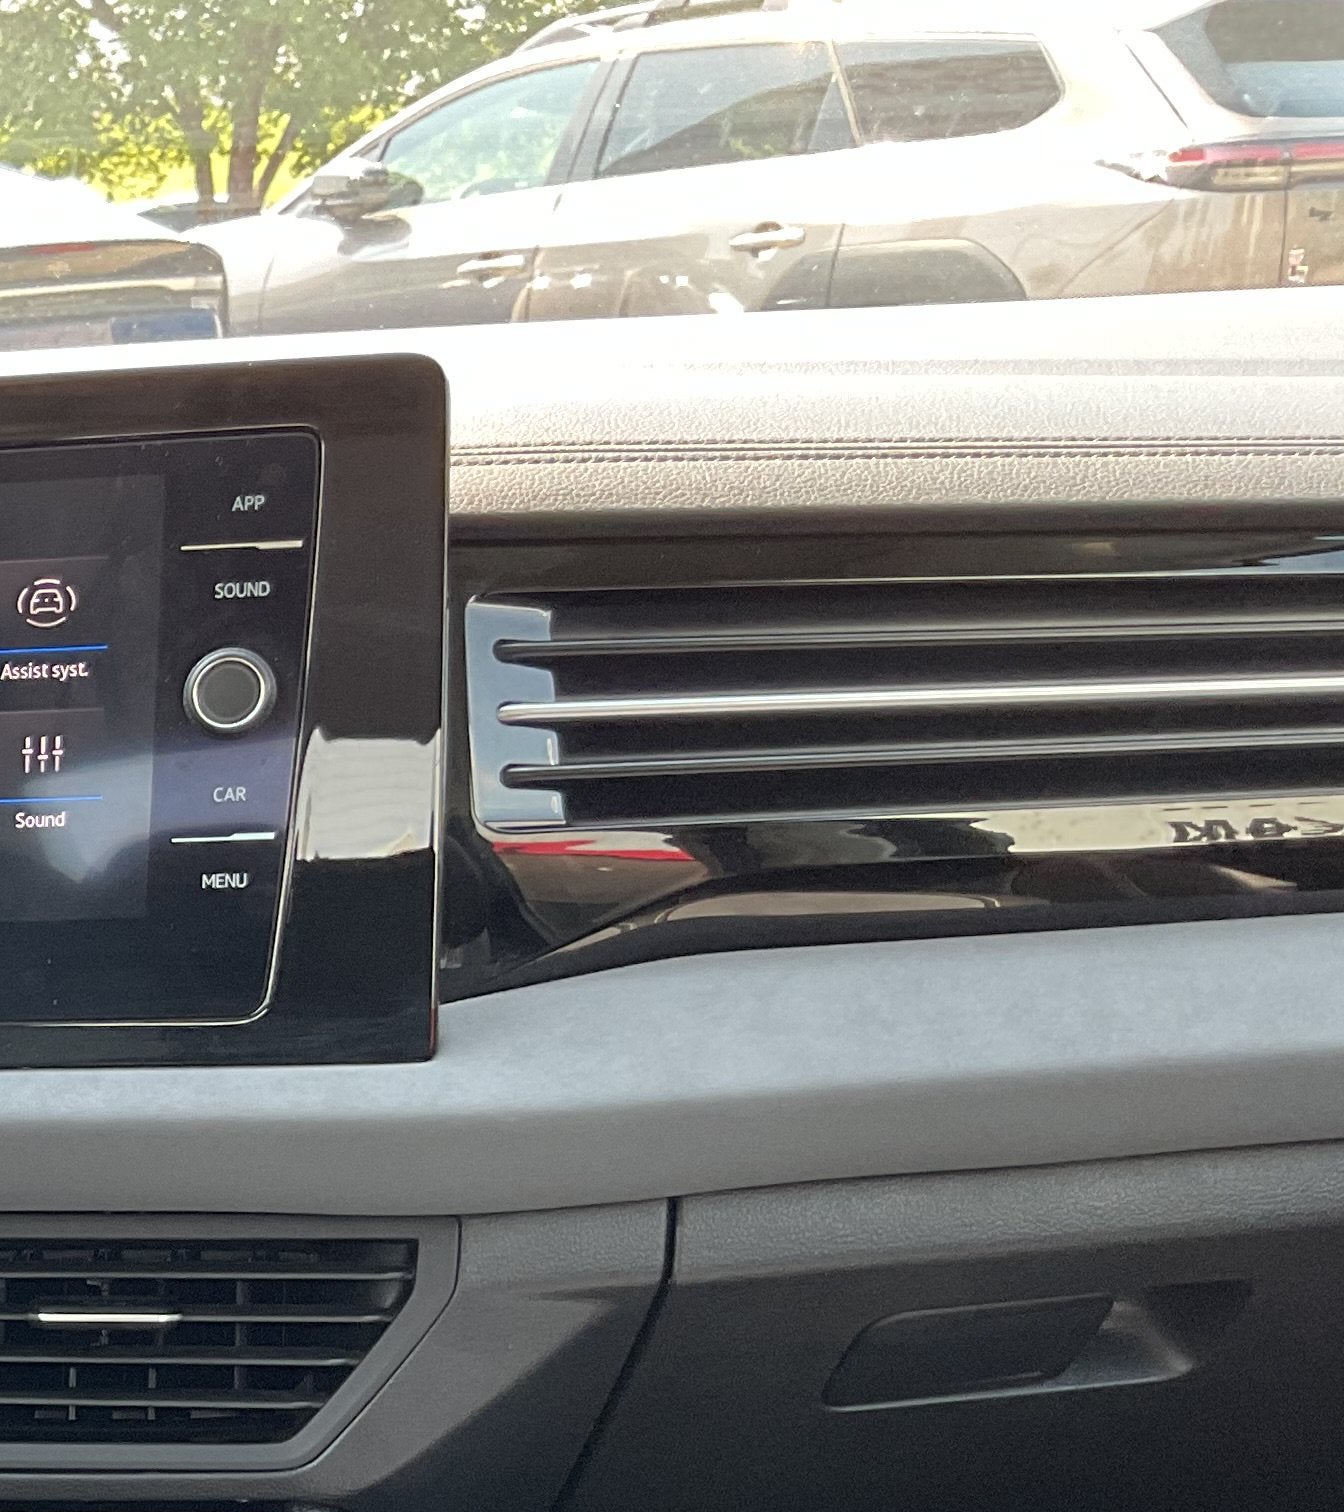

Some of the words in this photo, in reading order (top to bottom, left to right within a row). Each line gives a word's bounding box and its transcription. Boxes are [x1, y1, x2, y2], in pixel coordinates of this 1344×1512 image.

[231, 494, 265, 511] APP
[214, 580, 271, 599] SOUND
[0, 661, 49, 680] Assist
[212, 785, 247, 803] CAR
[14, 809, 66, 829] Sound
[201, 872, 248, 890] MENU
